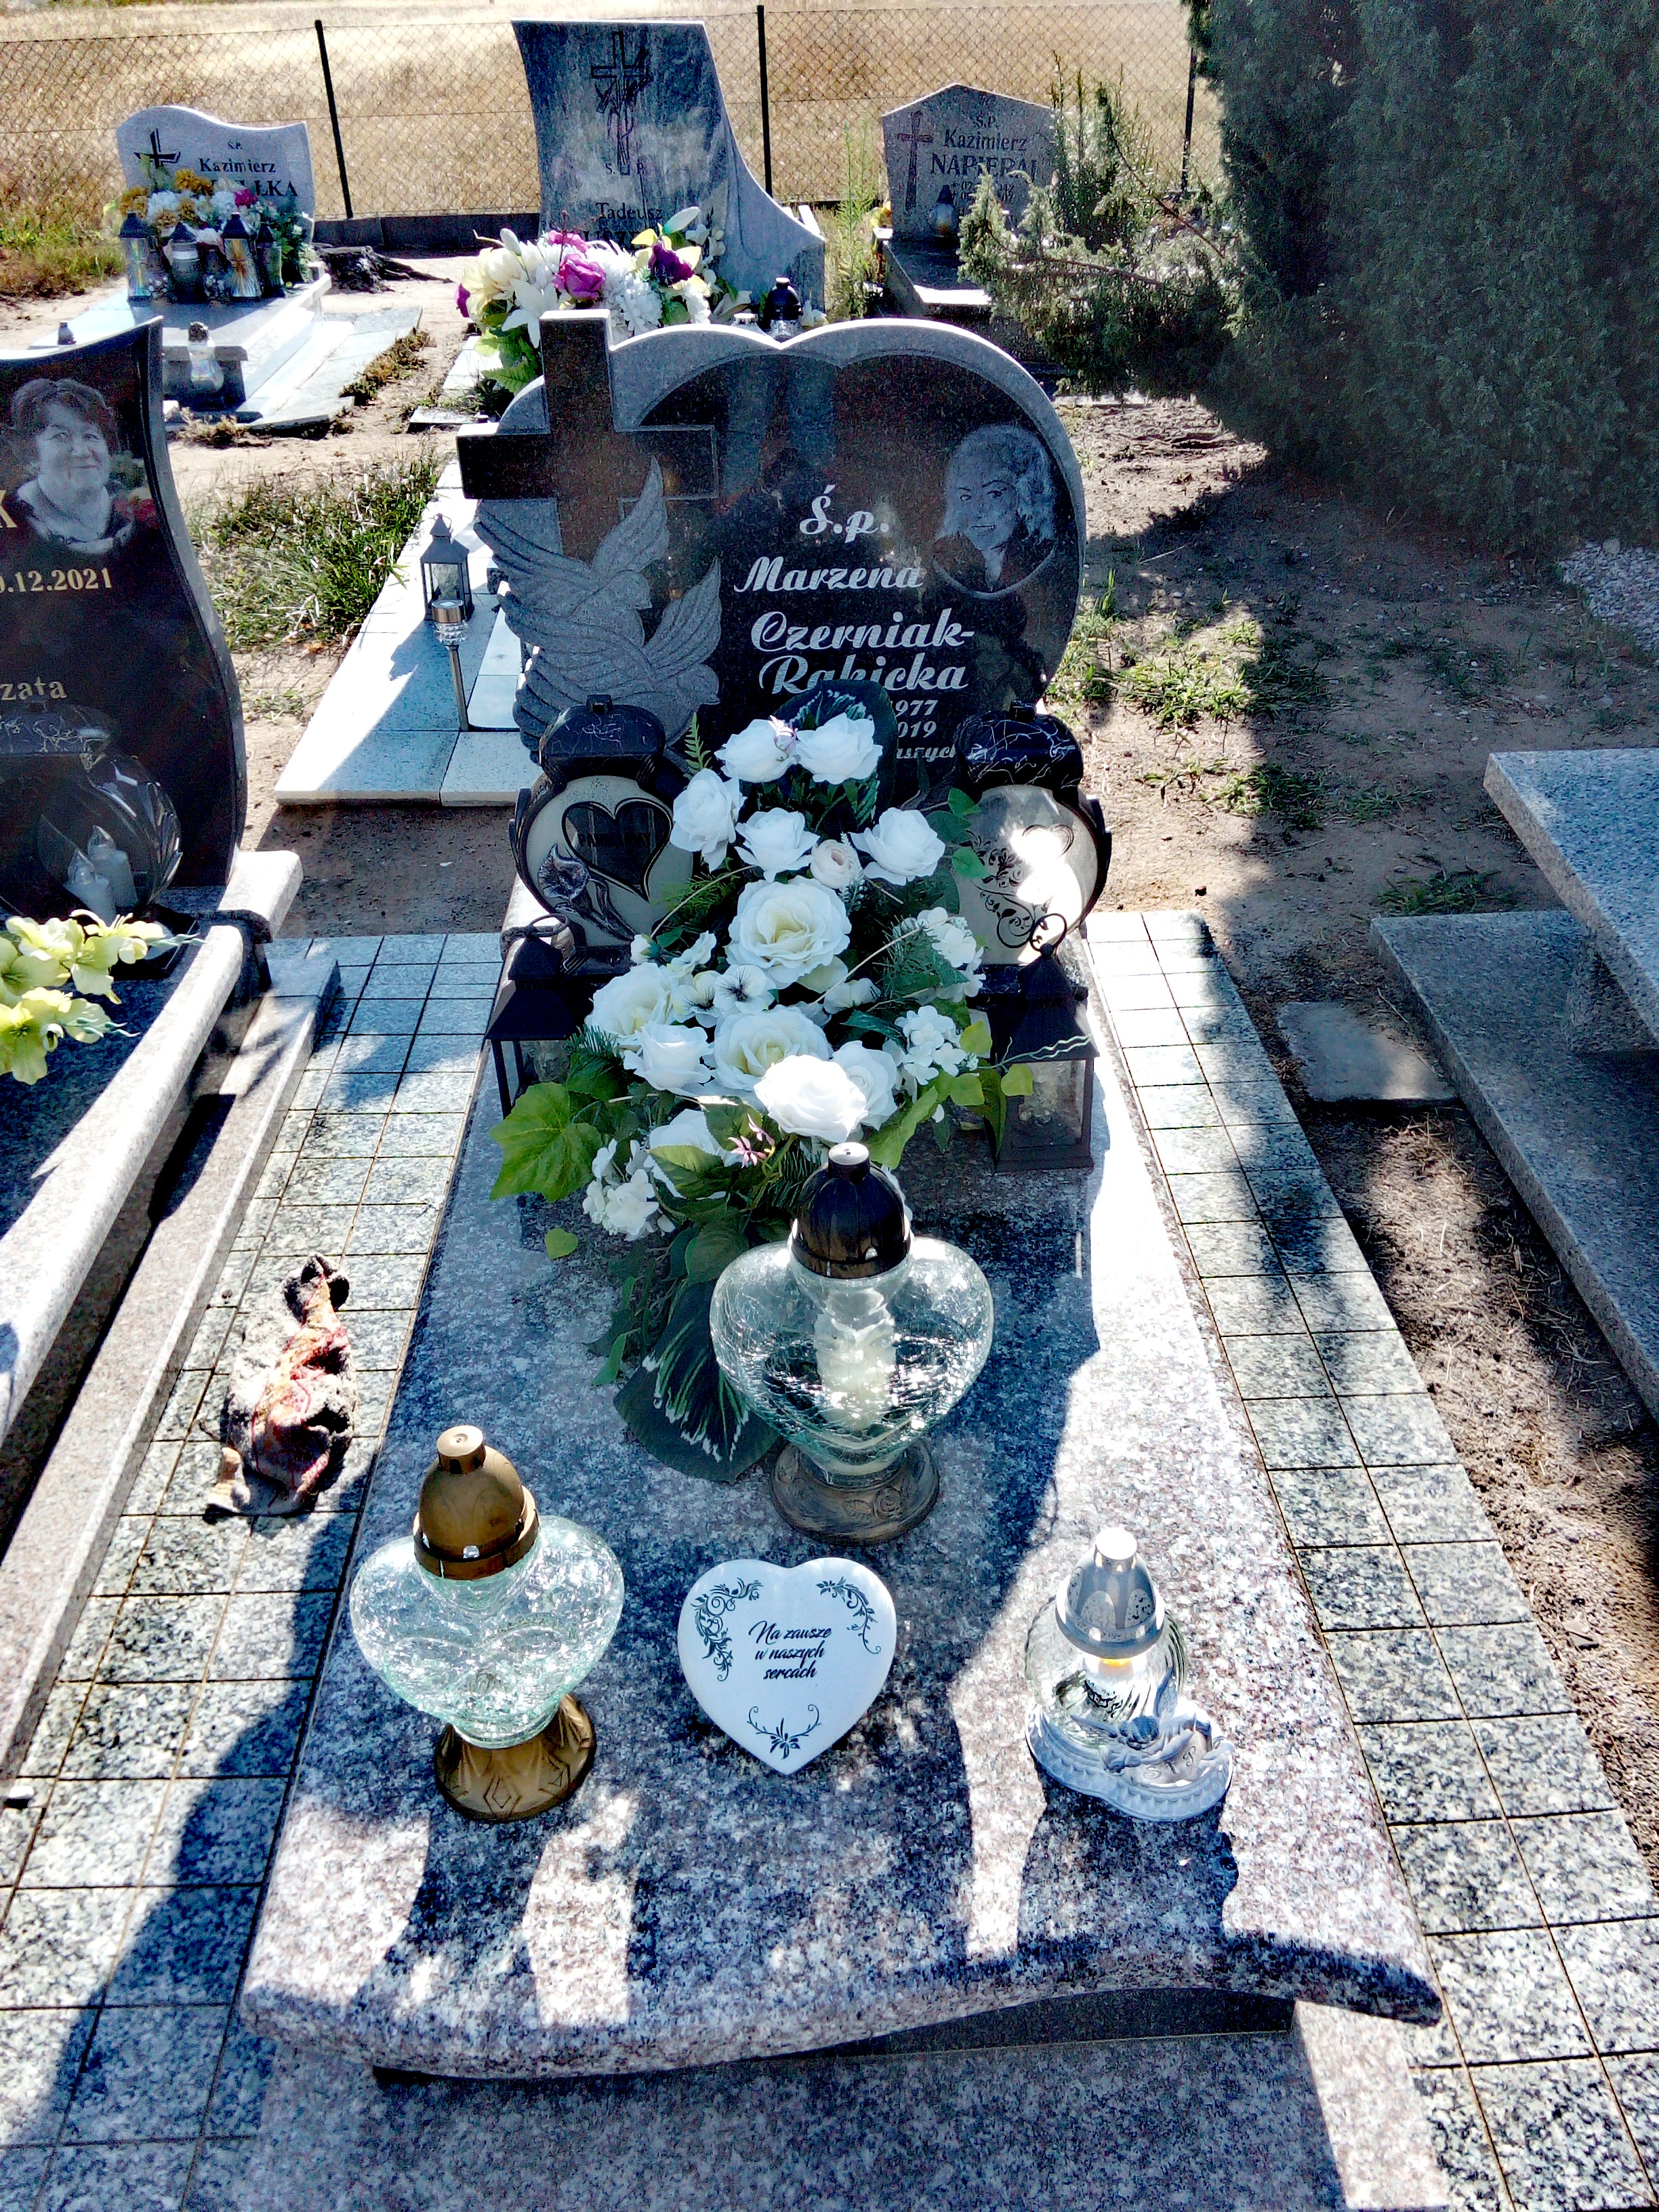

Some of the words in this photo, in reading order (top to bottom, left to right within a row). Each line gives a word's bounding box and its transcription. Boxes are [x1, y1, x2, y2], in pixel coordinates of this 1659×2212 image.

[942, 129, 1027, 151] Kazimierz
[199, 158, 276, 173] Kazimierz
[595, 202, 663, 220] Tadeusz
[800, 485, 889, 543] Ś.p.
[734, 556, 924, 592] Marzena
[751, 608, 975, 652] Czerniak-
[748, 1620, 780, 1645] Na
[783, 1627, 832, 1639] zawsze
[755, 1647, 769, 1660] w
[769, 1640, 825, 1668] naszych
[763, 1660, 817, 1680] sercach
